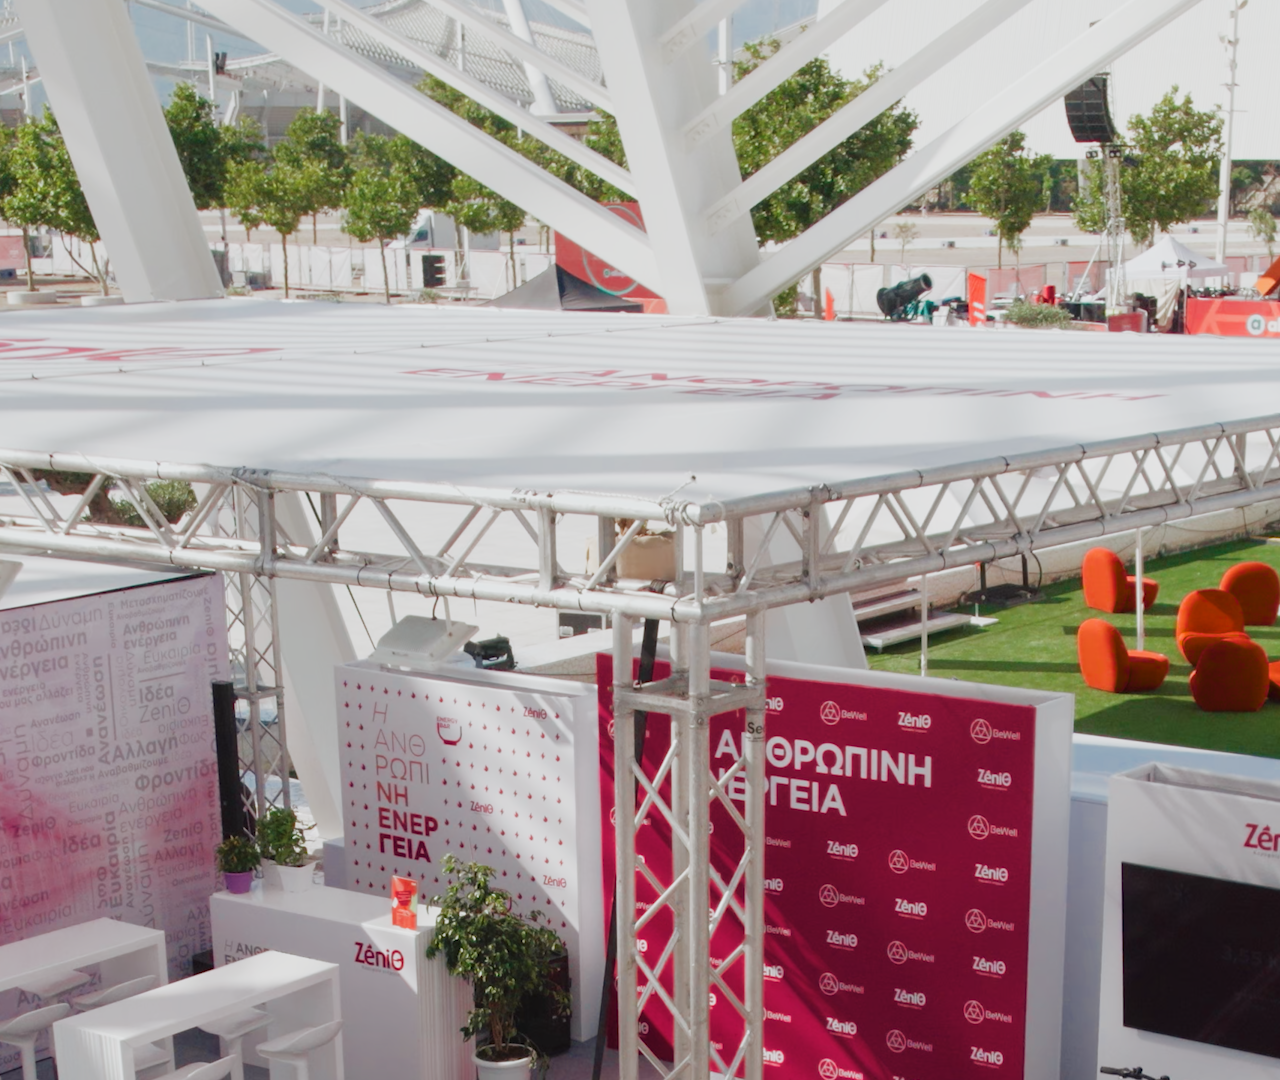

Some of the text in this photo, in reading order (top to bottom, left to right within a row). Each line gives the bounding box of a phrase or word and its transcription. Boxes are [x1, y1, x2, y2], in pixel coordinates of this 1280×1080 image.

[123, 615, 190, 637] Ανθρώπινη
[124, 630, 177, 651] ενέργεια
[139, 683, 174, 704] Ιδέα
[373, 702, 388, 724] Η
[841, 709, 867, 721] BeWell
[992, 728, 1021, 740] BeWell
[112, 732, 178, 763] Αλλαγή
[374, 729, 426, 757] ΑΝΘ
[32, 744, 95, 769] Φροντίδα
[714, 728, 933, 788] ΑΘΡΩΠΙΝΗ
[375, 754, 429, 785] ΡΩΠΙ
[377, 780, 408, 807] ΝΗ
[378, 807, 438, 837] ΕΝΕΡ
[990, 824, 1018, 837] BeWell
[379, 833, 432, 863] ΓΕΙΑ
[766, 837, 791, 848] BeWell
[909, 860, 936, 872] BeWell
[840, 894, 865, 905] BeWell
[767, 925, 791, 937] BeWell
[988, 919, 1015, 931] BeWell
[908, 951, 935, 963] BeWell
[839, 982, 864, 994] BeWell
[767, 1011, 791, 1023] BeWell
[985, 1011, 1012, 1024] BeWell
[907, 1039, 933, 1052] BeWell
[838, 1068, 863, 1080] BeWell
